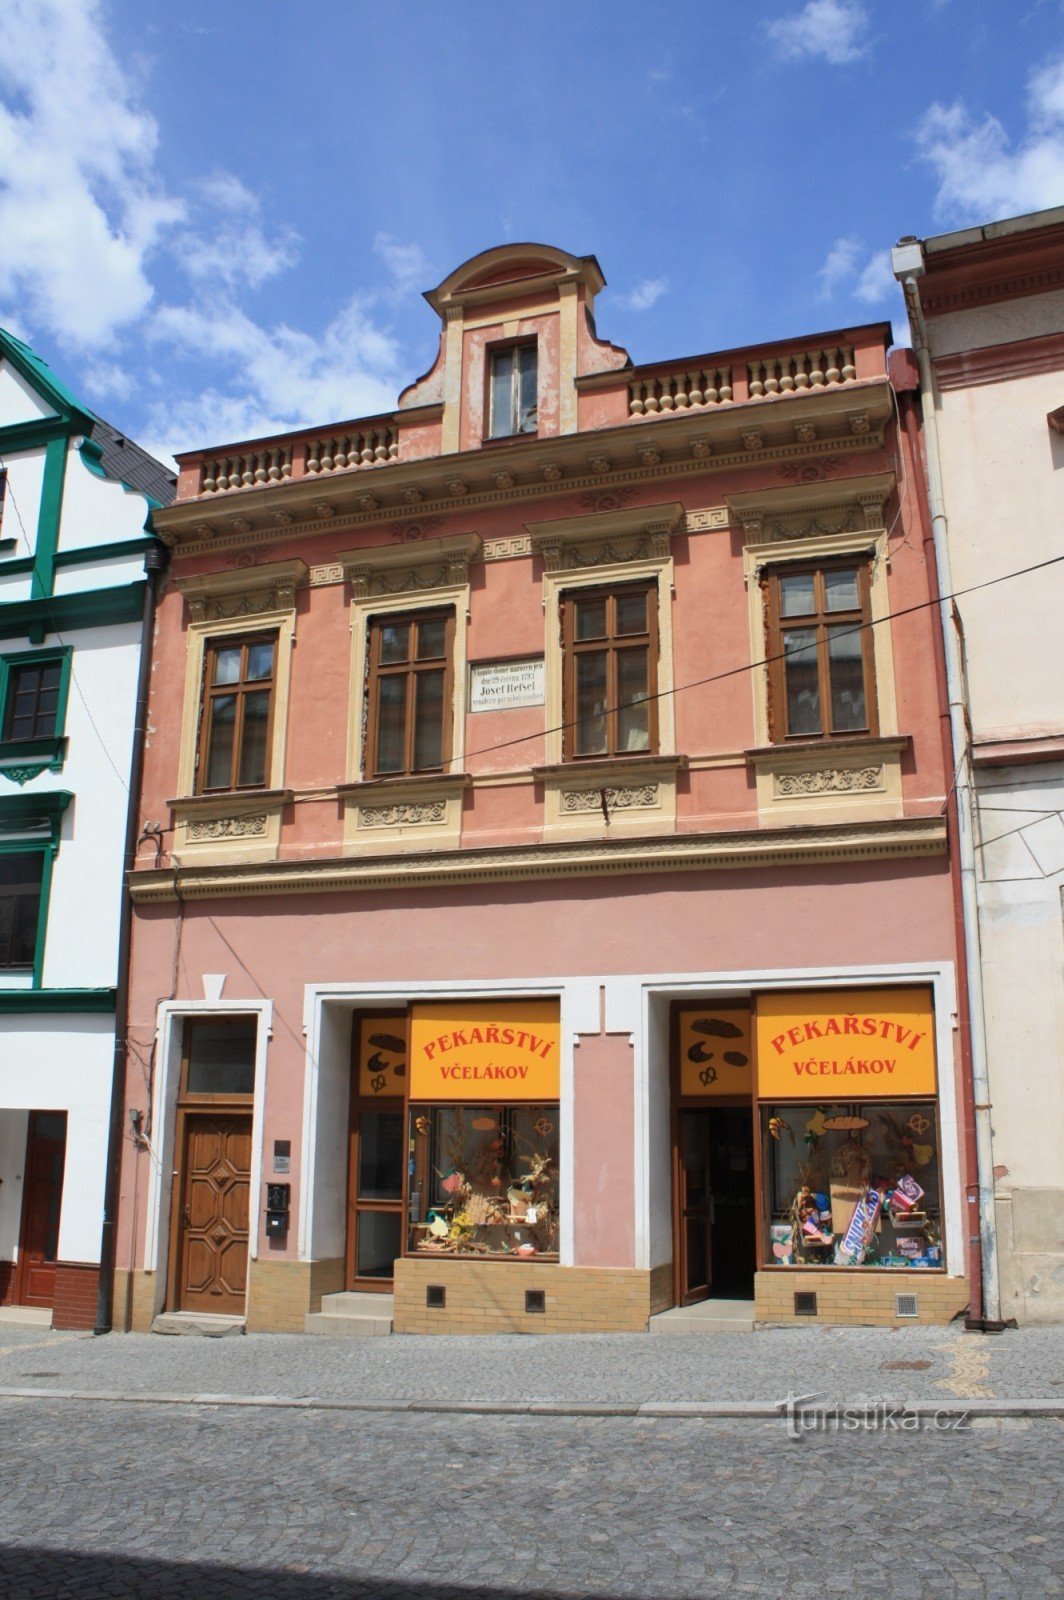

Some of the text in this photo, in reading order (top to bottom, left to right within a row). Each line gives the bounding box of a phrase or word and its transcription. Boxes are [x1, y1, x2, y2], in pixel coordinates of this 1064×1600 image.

[480, 684, 506, 696] Josef
[423, 1023, 555, 1060] PEKAŘSTVÍ
[770, 1013, 926, 1055] PEKAŘSTVÍ
[440, 1062, 529, 1079] VČELÁKOV
[793, 1056, 897, 1075] VČELÁKOV
